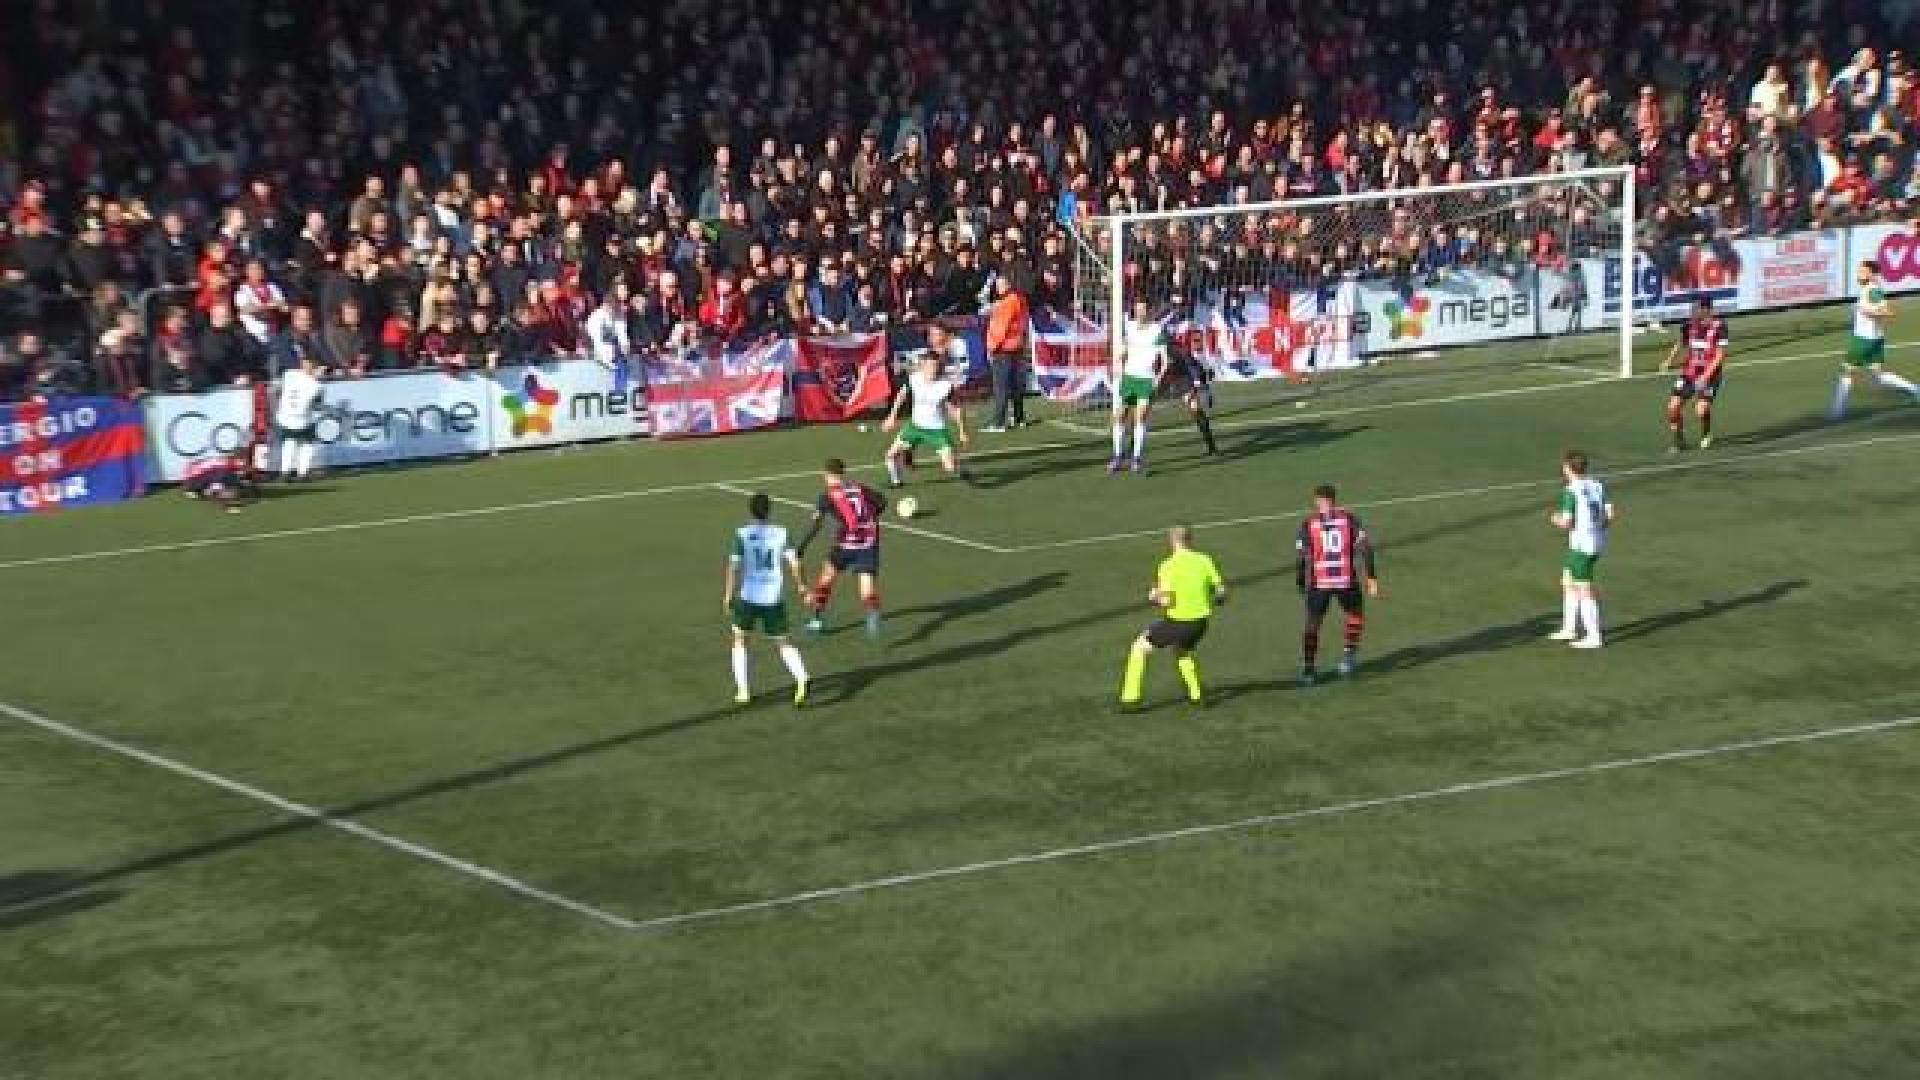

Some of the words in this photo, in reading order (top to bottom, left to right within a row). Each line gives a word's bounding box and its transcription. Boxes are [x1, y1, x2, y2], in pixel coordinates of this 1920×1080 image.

[1439, 293, 1529, 328] mega
[568, 386, 649, 424] meg
[1321, 529, 1343, 552] 10
[753, 547, 775, 571] 14
